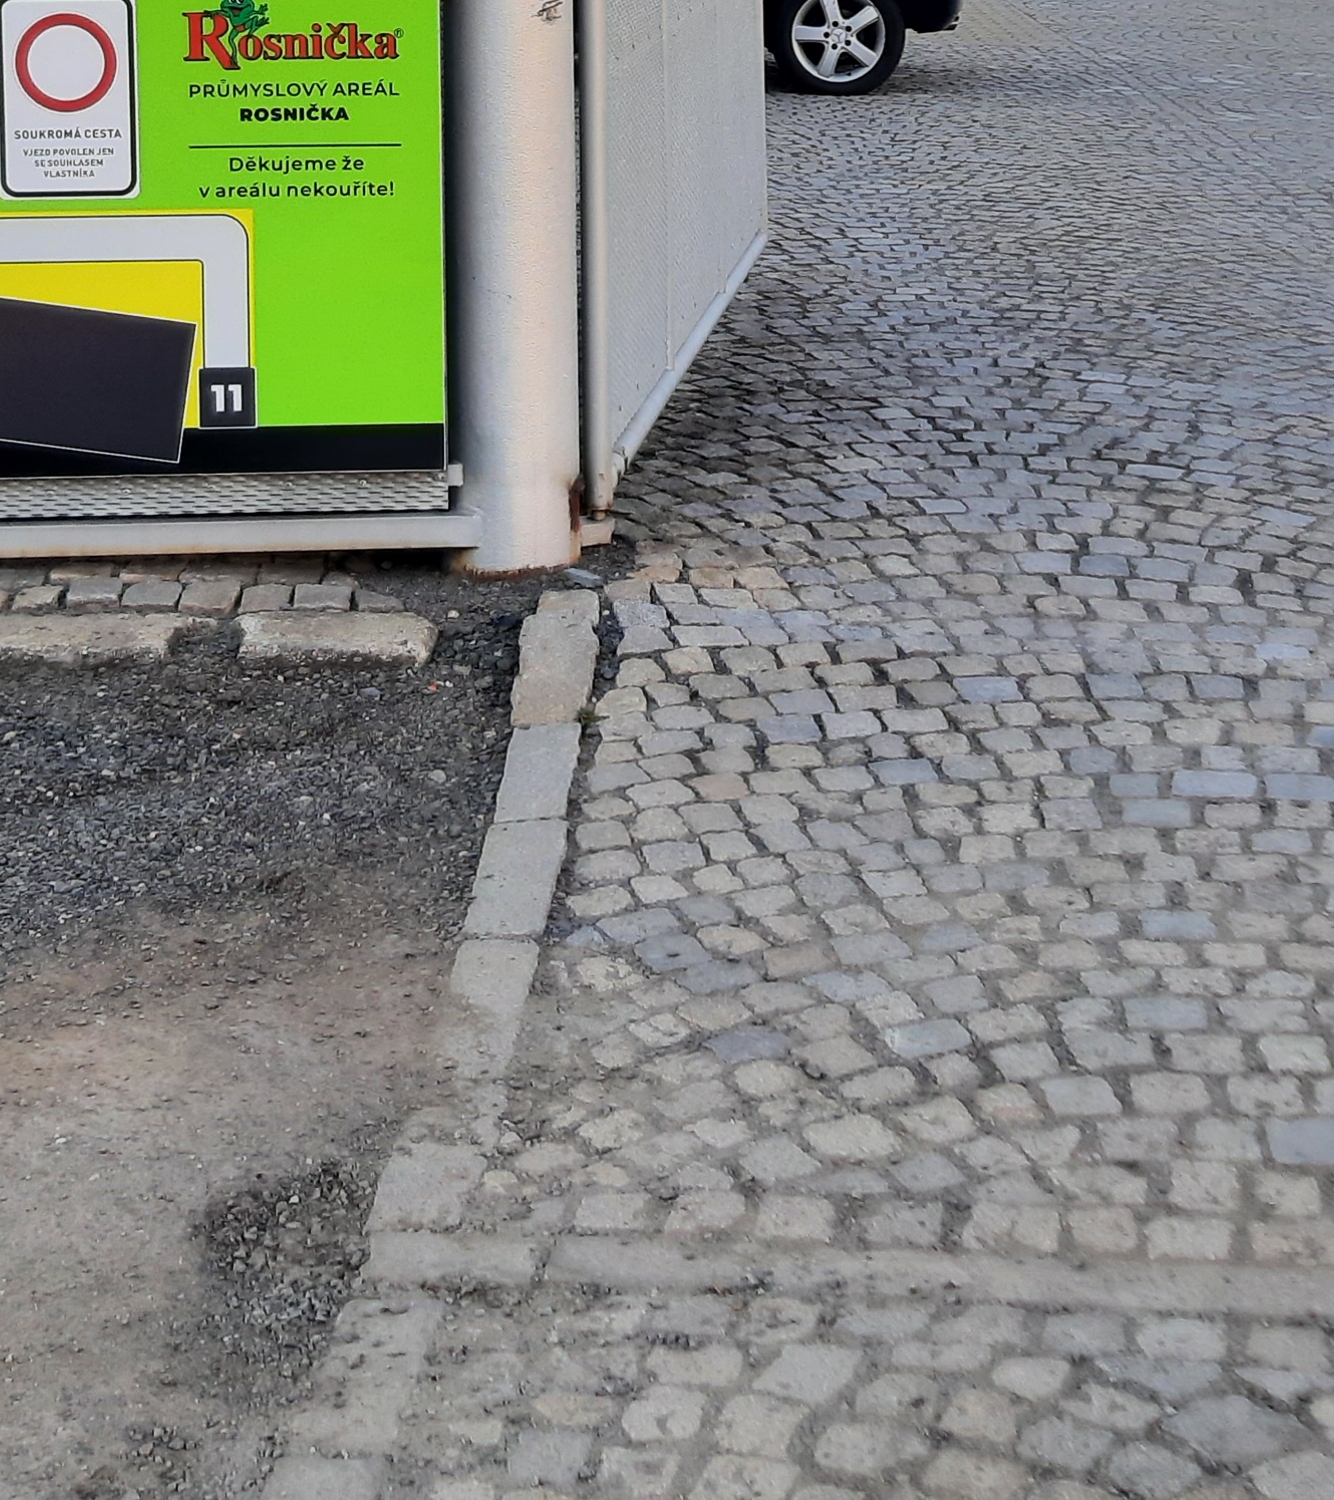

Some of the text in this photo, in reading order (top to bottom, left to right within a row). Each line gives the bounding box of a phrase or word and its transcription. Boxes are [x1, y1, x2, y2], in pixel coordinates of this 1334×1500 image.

[182, 12, 400, 70] Rosnička
[189, 78, 400, 98] PRŮMYSLOVÝ AREÁL
[239, 103, 350, 122] ROSNIČKA
[14, 126, 122, 140] SOUKROMÁ CESTA
[229, 155, 364, 175] Děkujeme že
[198, 181, 394, 198] v areálu nekouříte!
[210, 383, 243, 413] 11
